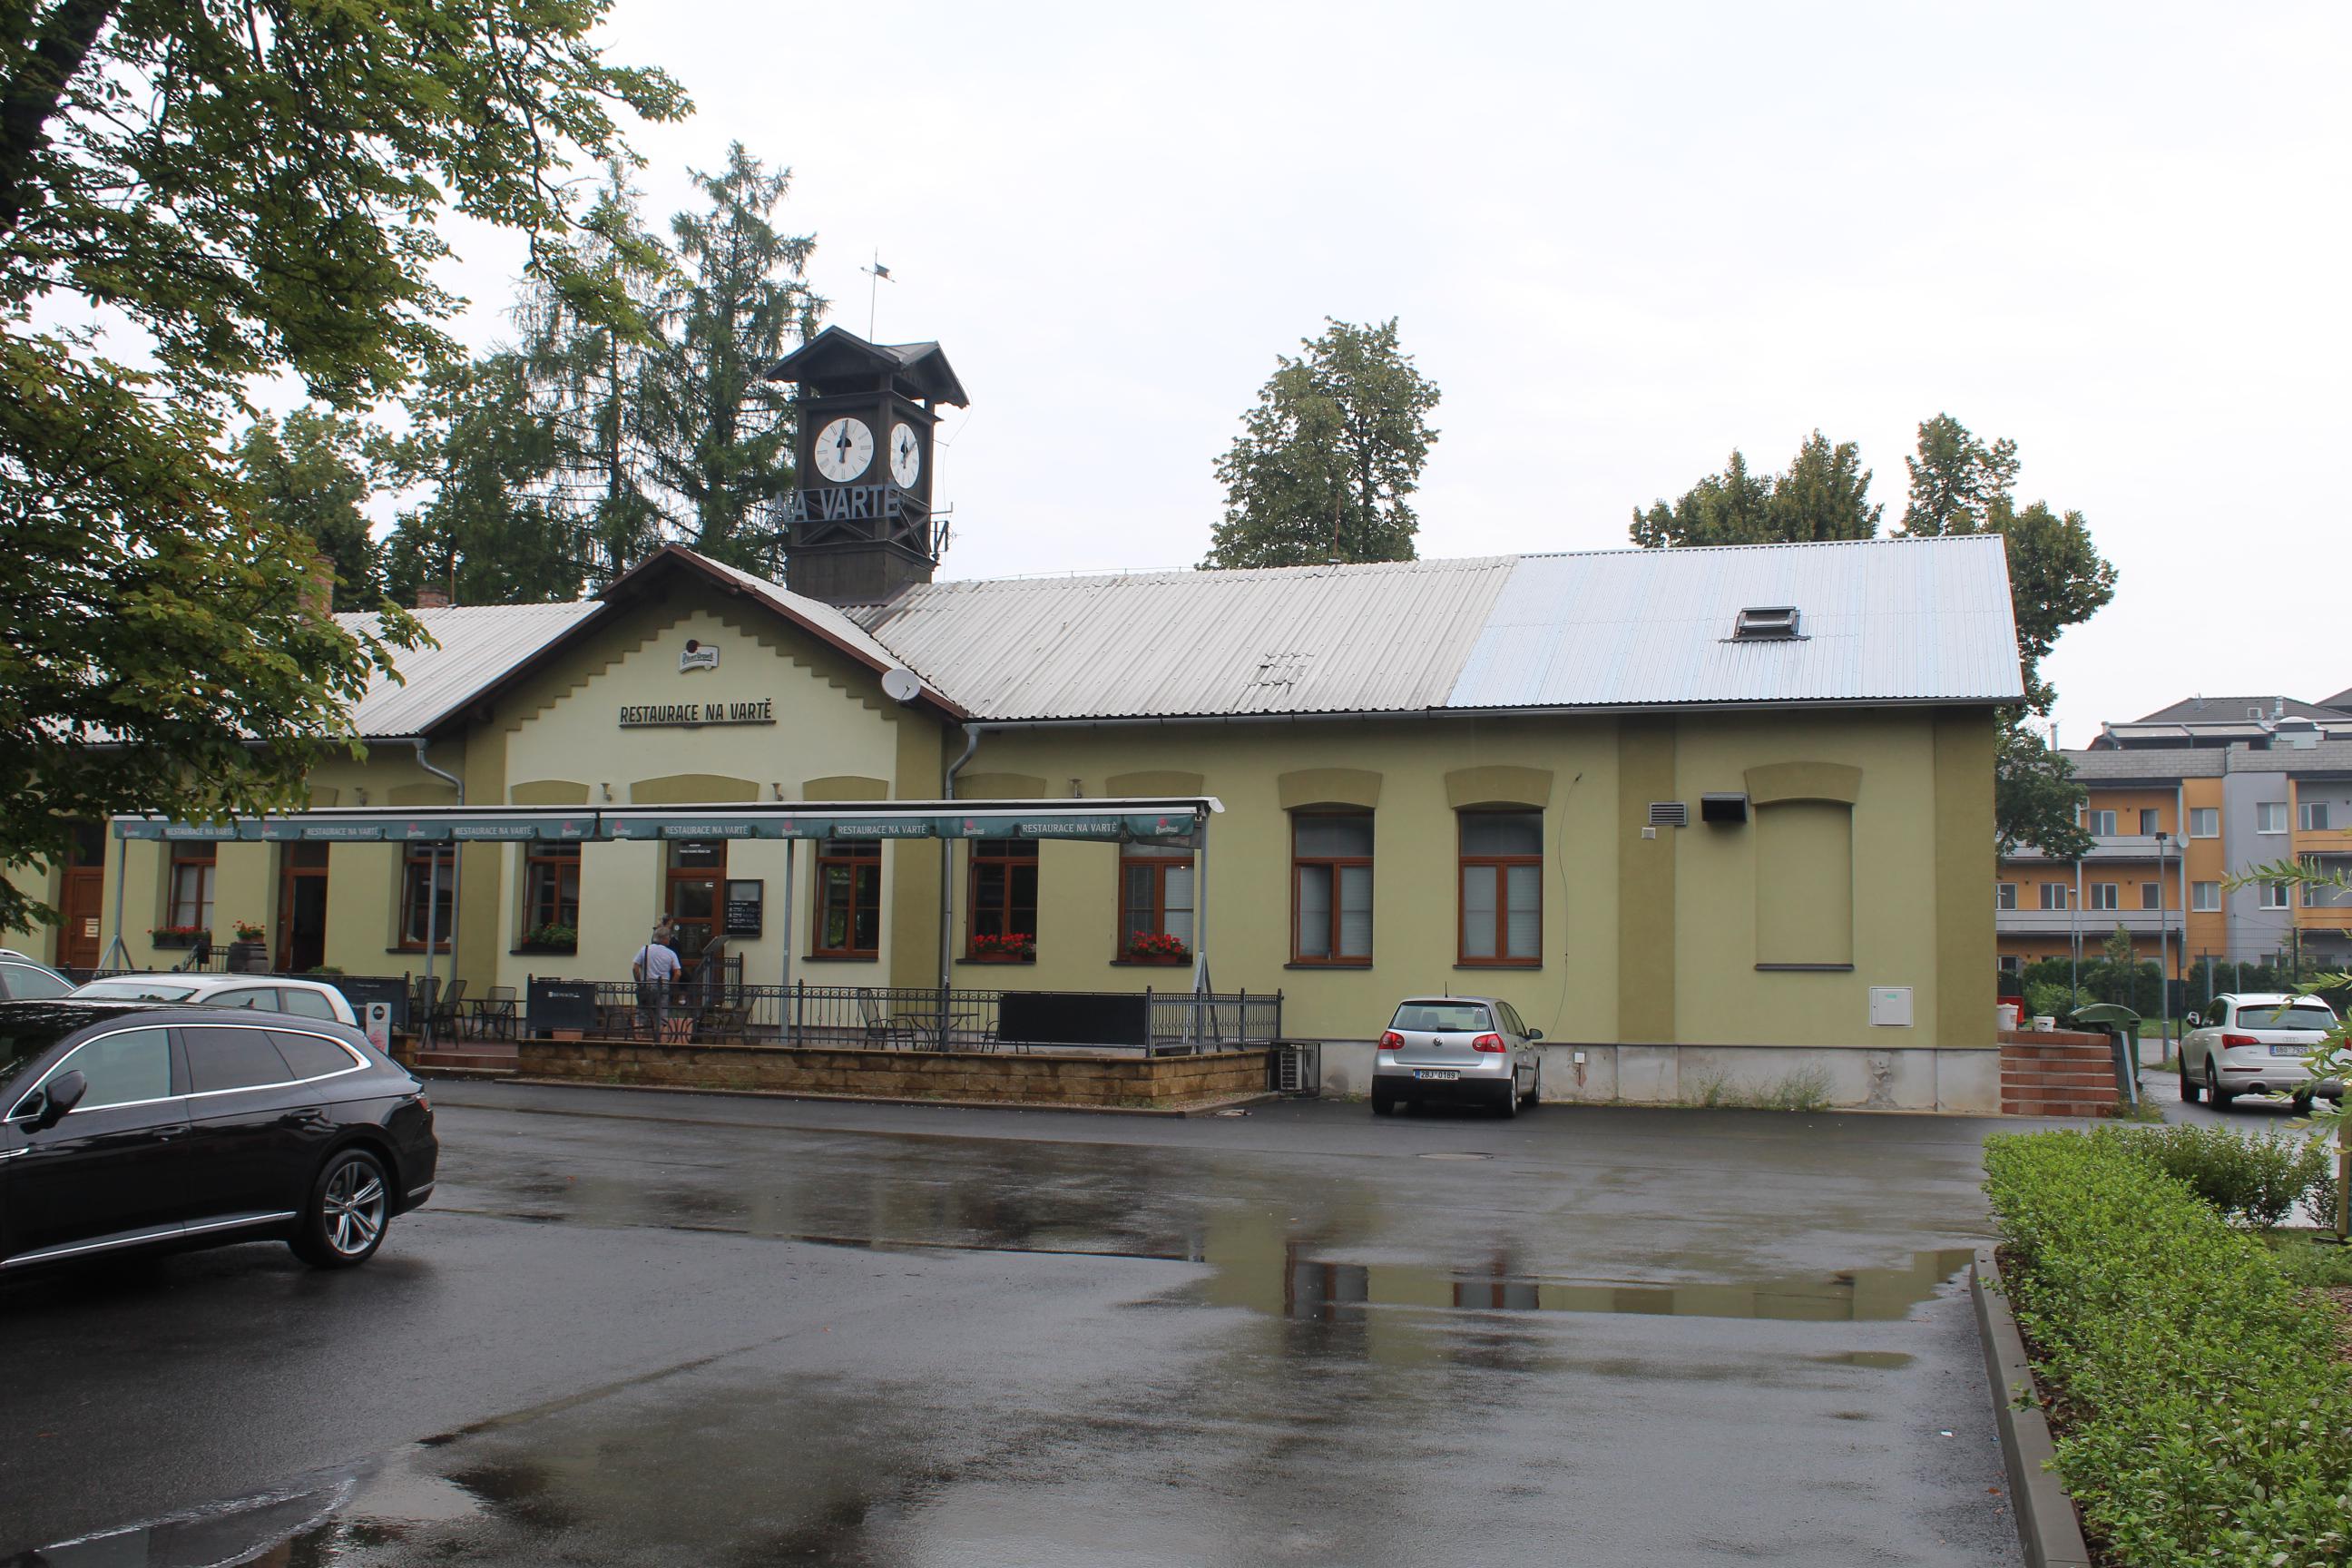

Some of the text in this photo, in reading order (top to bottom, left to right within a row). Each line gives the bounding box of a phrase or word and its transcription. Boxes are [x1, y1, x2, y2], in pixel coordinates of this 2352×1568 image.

[621, 698, 771, 722] RESTAURACE NA VARTĚ
[455, 828, 498, 836] RESTAURACE
[499, 827, 508, 835] NA
[665, 827, 710, 835] RESTAURACE
[712, 826, 722, 835] NA
[838, 826, 886, 835] RESTAURACE
[889, 826, 899, 834] NA
[1023, 824, 1073, 833] RESTAURACE
[1076, 824, 1088, 832] NA
[1421, 1071, 1455, 1079] 2BJ 0189
